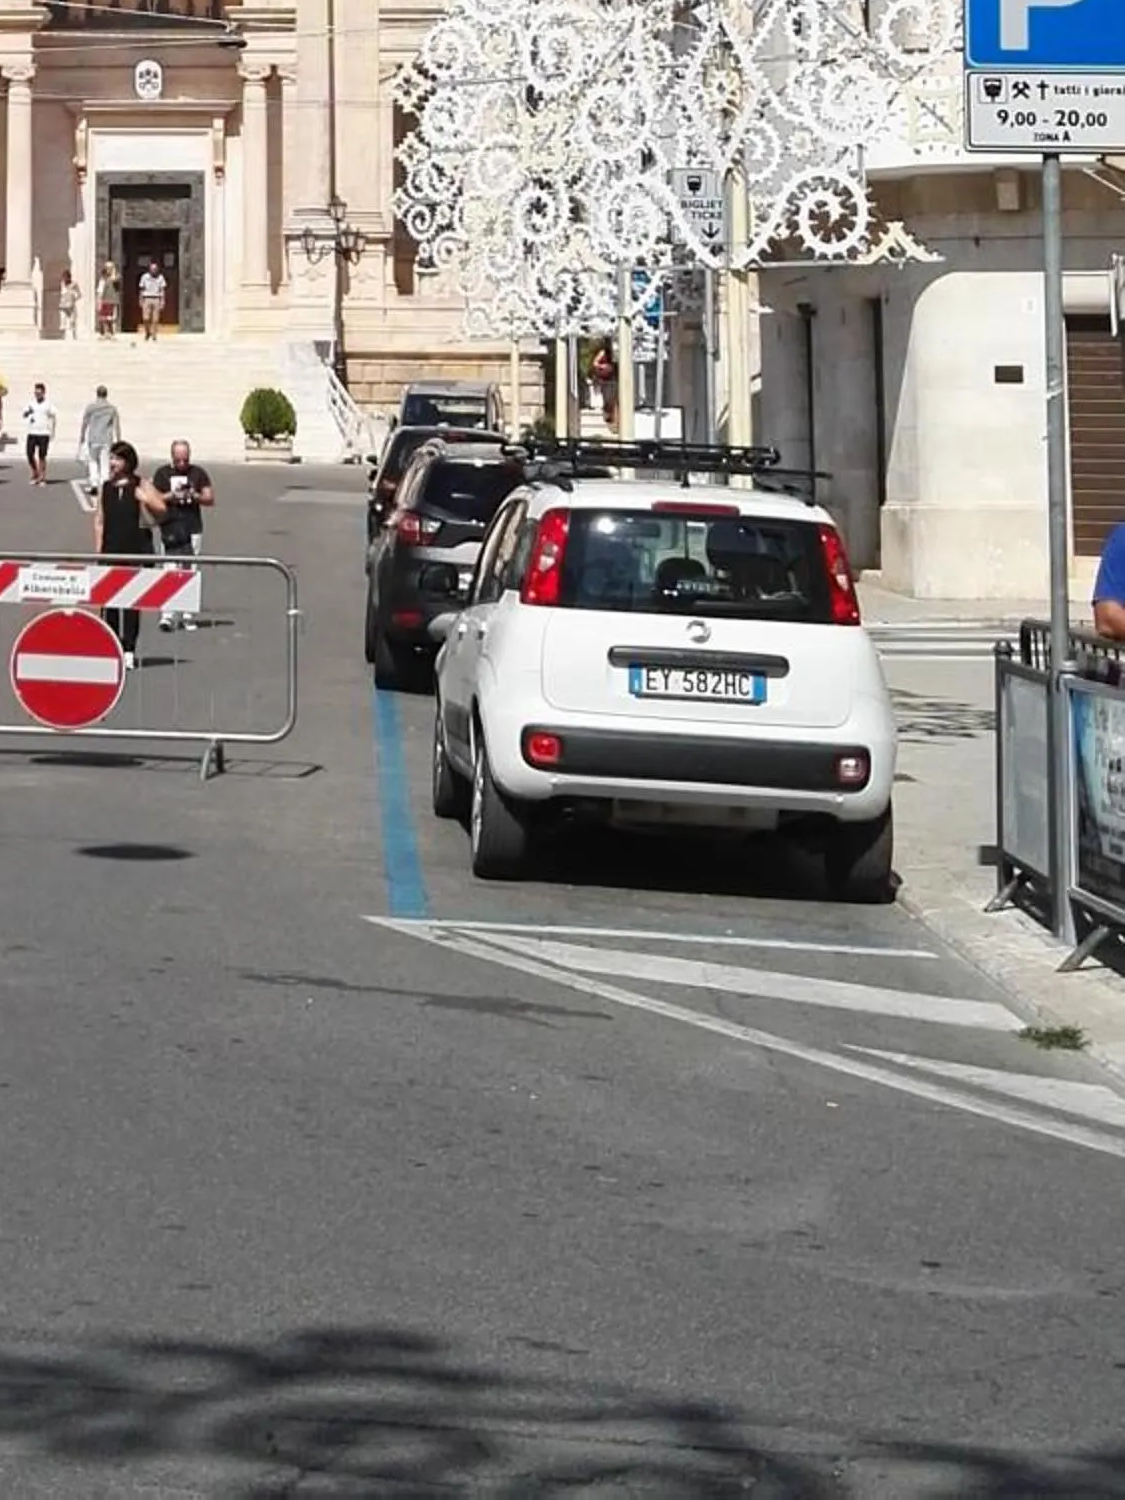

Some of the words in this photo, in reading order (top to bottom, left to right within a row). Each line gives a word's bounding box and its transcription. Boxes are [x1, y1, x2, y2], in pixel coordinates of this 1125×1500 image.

[996, 109, 1037, 128] 9,00
[1054, 109, 1107, 128] 20,00
[1033, 132, 1059, 142] ZONA
[1062, 130, 1071, 142] A
[646, 668, 672, 691] EY
[682, 670, 751, 697] 582HC
